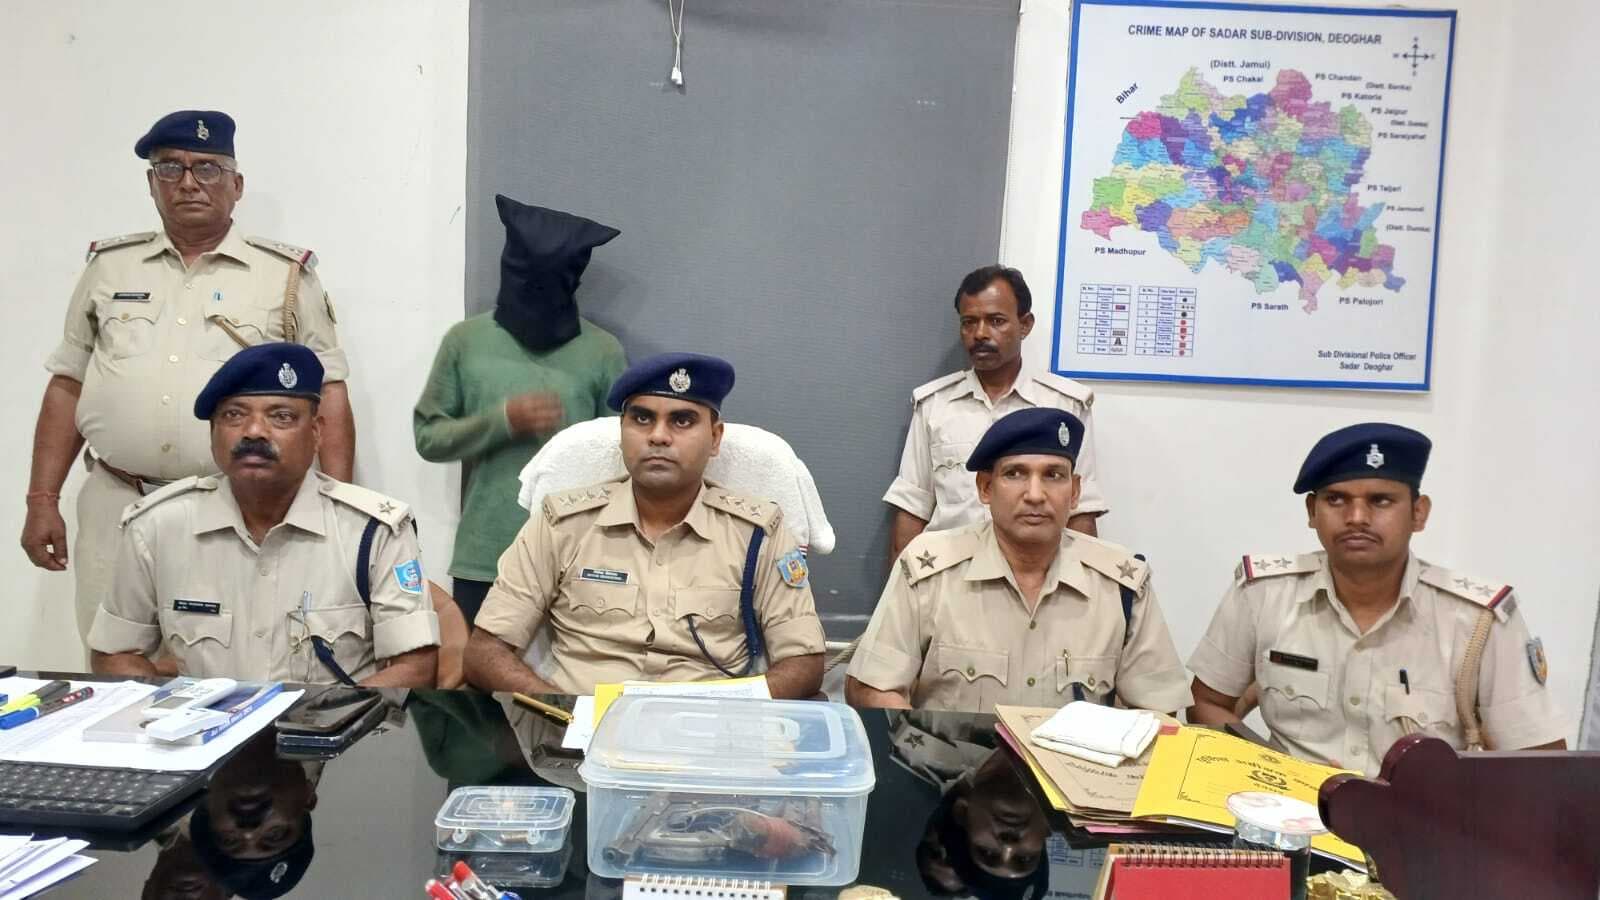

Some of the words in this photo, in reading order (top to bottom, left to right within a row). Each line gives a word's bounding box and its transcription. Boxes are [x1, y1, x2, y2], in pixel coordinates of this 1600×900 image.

[1128, 24, 1162, 36] CRIME
[1165, 26, 1189, 37] MAP
[1191, 27, 1206, 38] OF
[1209, 28, 1247, 39] SADAR
[1250, 29, 1325, 43] SUB-DIVISION,
[1328, 33, 1382, 44] DEOGHAR
[1116, 82, 1138, 104] Bihar
[1341, 92, 1352, 100] PS
[1107, 247, 1146, 256] Madhupur
[1339, 296, 1351, 304] PS
[1251, 302, 1262, 310] PS
[1318, 350, 1333, 359] Sub
[1333, 350, 1369, 360] Divisional
[1369, 351, 1392, 360] Police
[1393, 352, 1417, 361] Officer
[1340, 361, 1361, 370] Sadar
